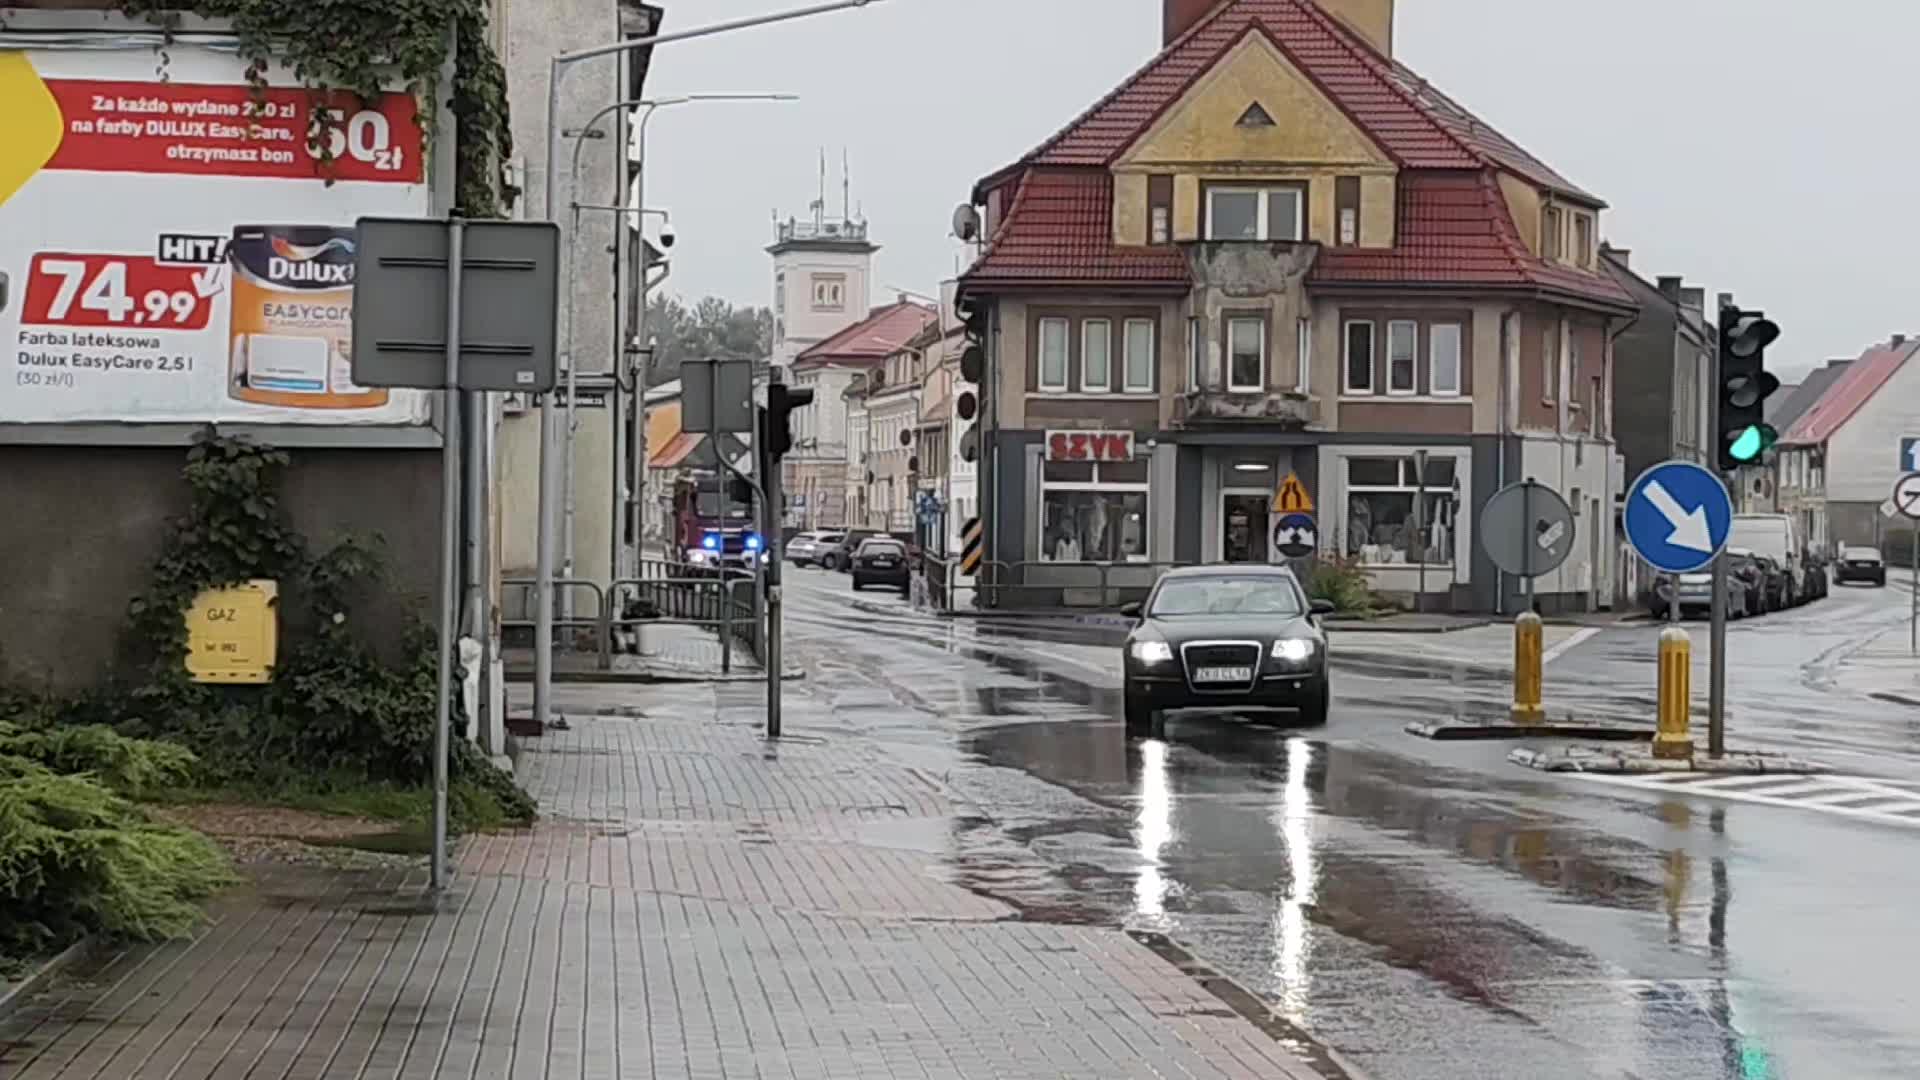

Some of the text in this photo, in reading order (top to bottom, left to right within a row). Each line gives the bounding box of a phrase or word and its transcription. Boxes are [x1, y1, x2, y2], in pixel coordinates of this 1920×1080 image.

[92, 95, 115, 111] Za
[171, 100, 239, 117] wydane
[71, 120, 93, 133] na
[96, 117, 144, 138] farby
[146, 120, 205, 137] DULUX
[167, 143, 294, 163] otrzymasz bon
[163, 237, 226, 262] HIT!
[269, 257, 347, 282] Dulux
[40, 259, 196, 323] 74,99
[19, 331, 160, 349] Farba lateksowa
[18, 351, 67, 367] Dulux
[72, 353, 154, 371] EasyCare
[157, 356, 184, 372] 2,5
[17, 371, 41, 386] (30
[1050, 433, 1130, 461] SZYK
[206, 608, 236, 622] GAZ
